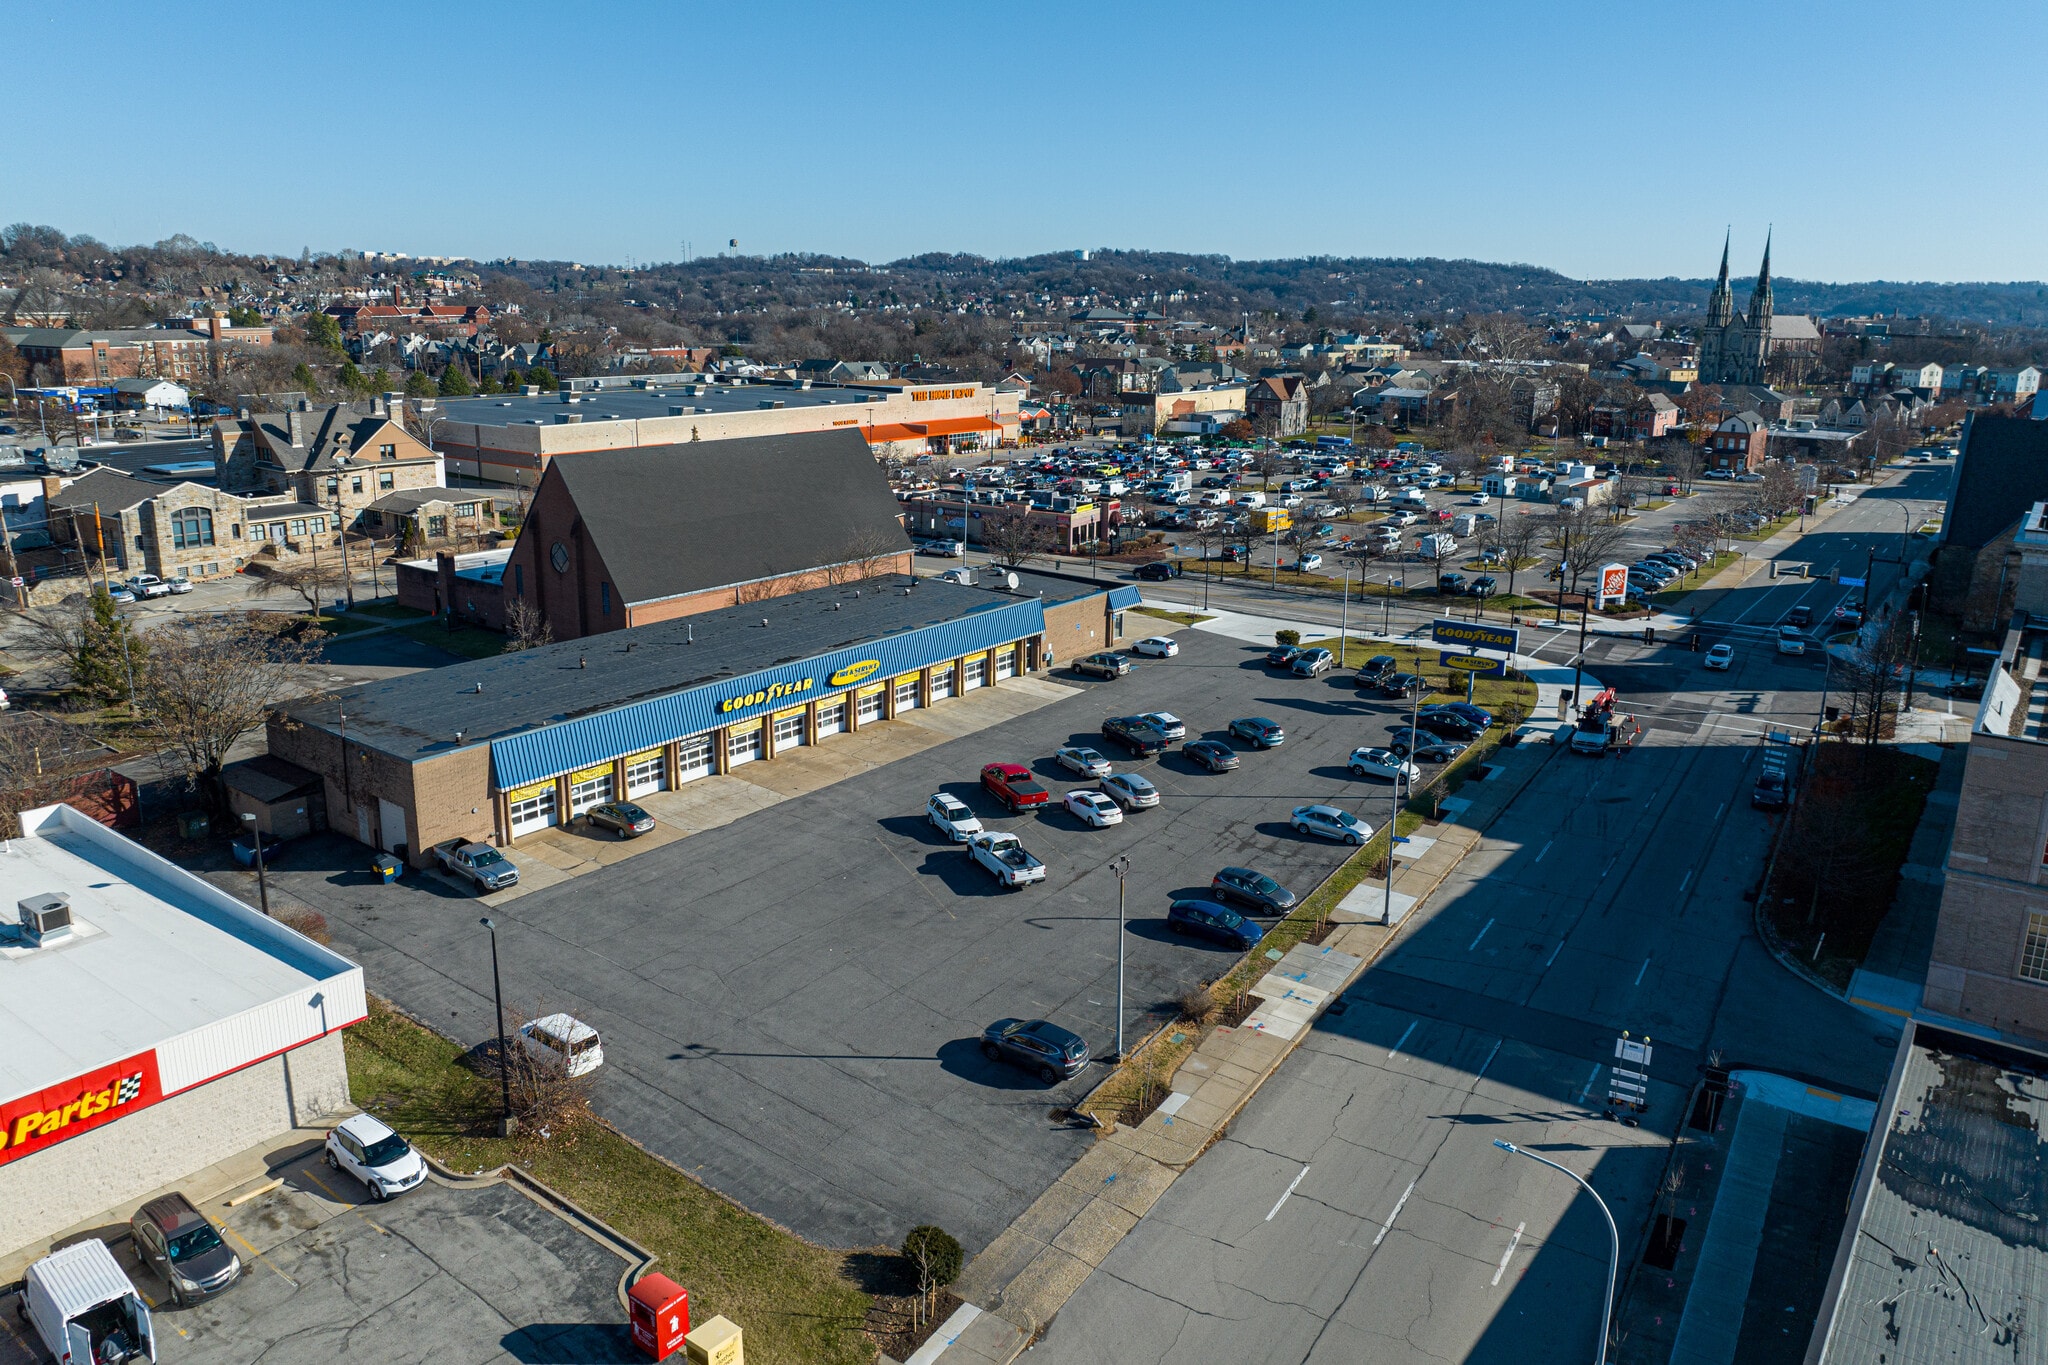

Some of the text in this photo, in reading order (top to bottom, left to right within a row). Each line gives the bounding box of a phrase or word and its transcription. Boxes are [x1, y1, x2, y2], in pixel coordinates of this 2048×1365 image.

[911, 387, 976, 401] THE HOME DEPOT
[1604, 570, 1625, 595] HOME
[1607, 573, 1616, 584] THE
[1436, 627, 1513, 645] GOODYEAR
[836, 669, 849, 679] TIRE
[854, 662, 878, 673] SERVICE
[1469, 659, 1496, 667] SERVICE
[722, 678, 814, 713] GOODYEAR
[13, 1089, 111, 1147] Parts
